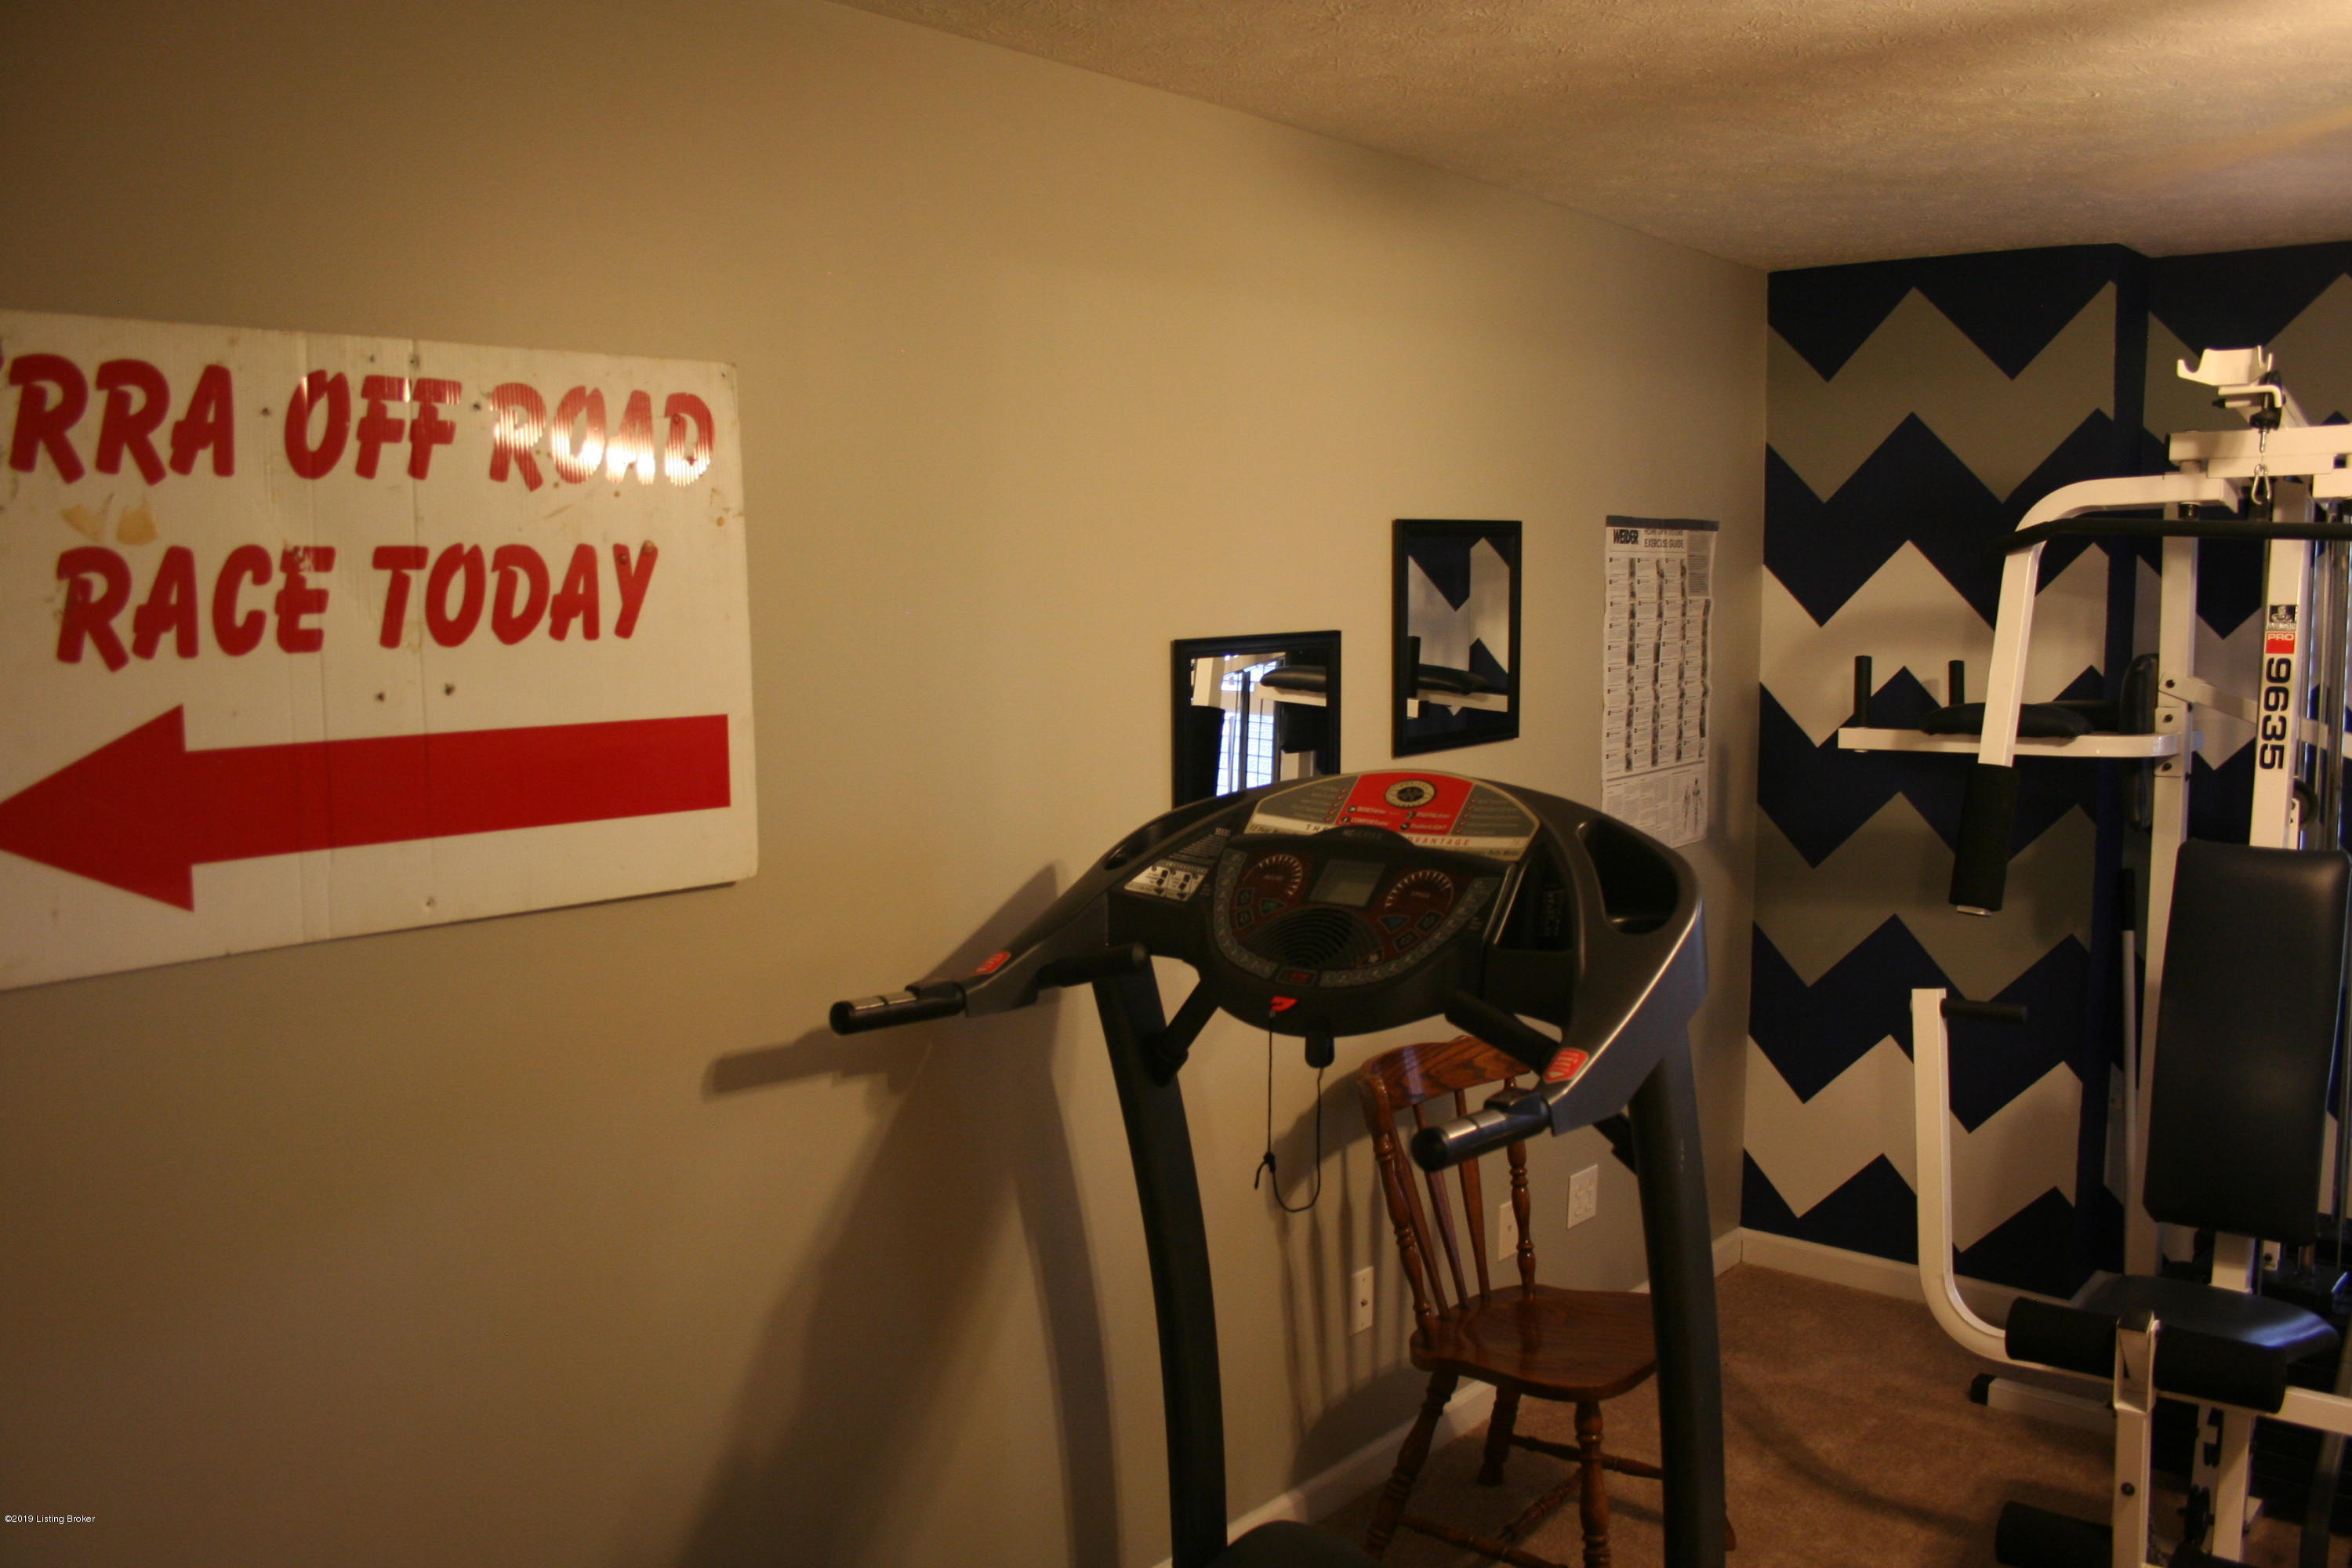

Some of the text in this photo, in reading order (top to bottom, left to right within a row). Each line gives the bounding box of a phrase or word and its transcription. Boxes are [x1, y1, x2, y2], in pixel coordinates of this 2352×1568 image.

[0, 353, 716, 492] RRA OFF ROAD
[1613, 528, 1639, 545] WEIDER
[1644, 539, 1684, 548] EXERCISE GUIDE
[56, 542, 659, 672] RACE TODAY
[2267, 633, 2295, 641] PRO
[2259, 657, 2292, 770] 9635
[1407, 836, 1471, 846] DVANTAGE
